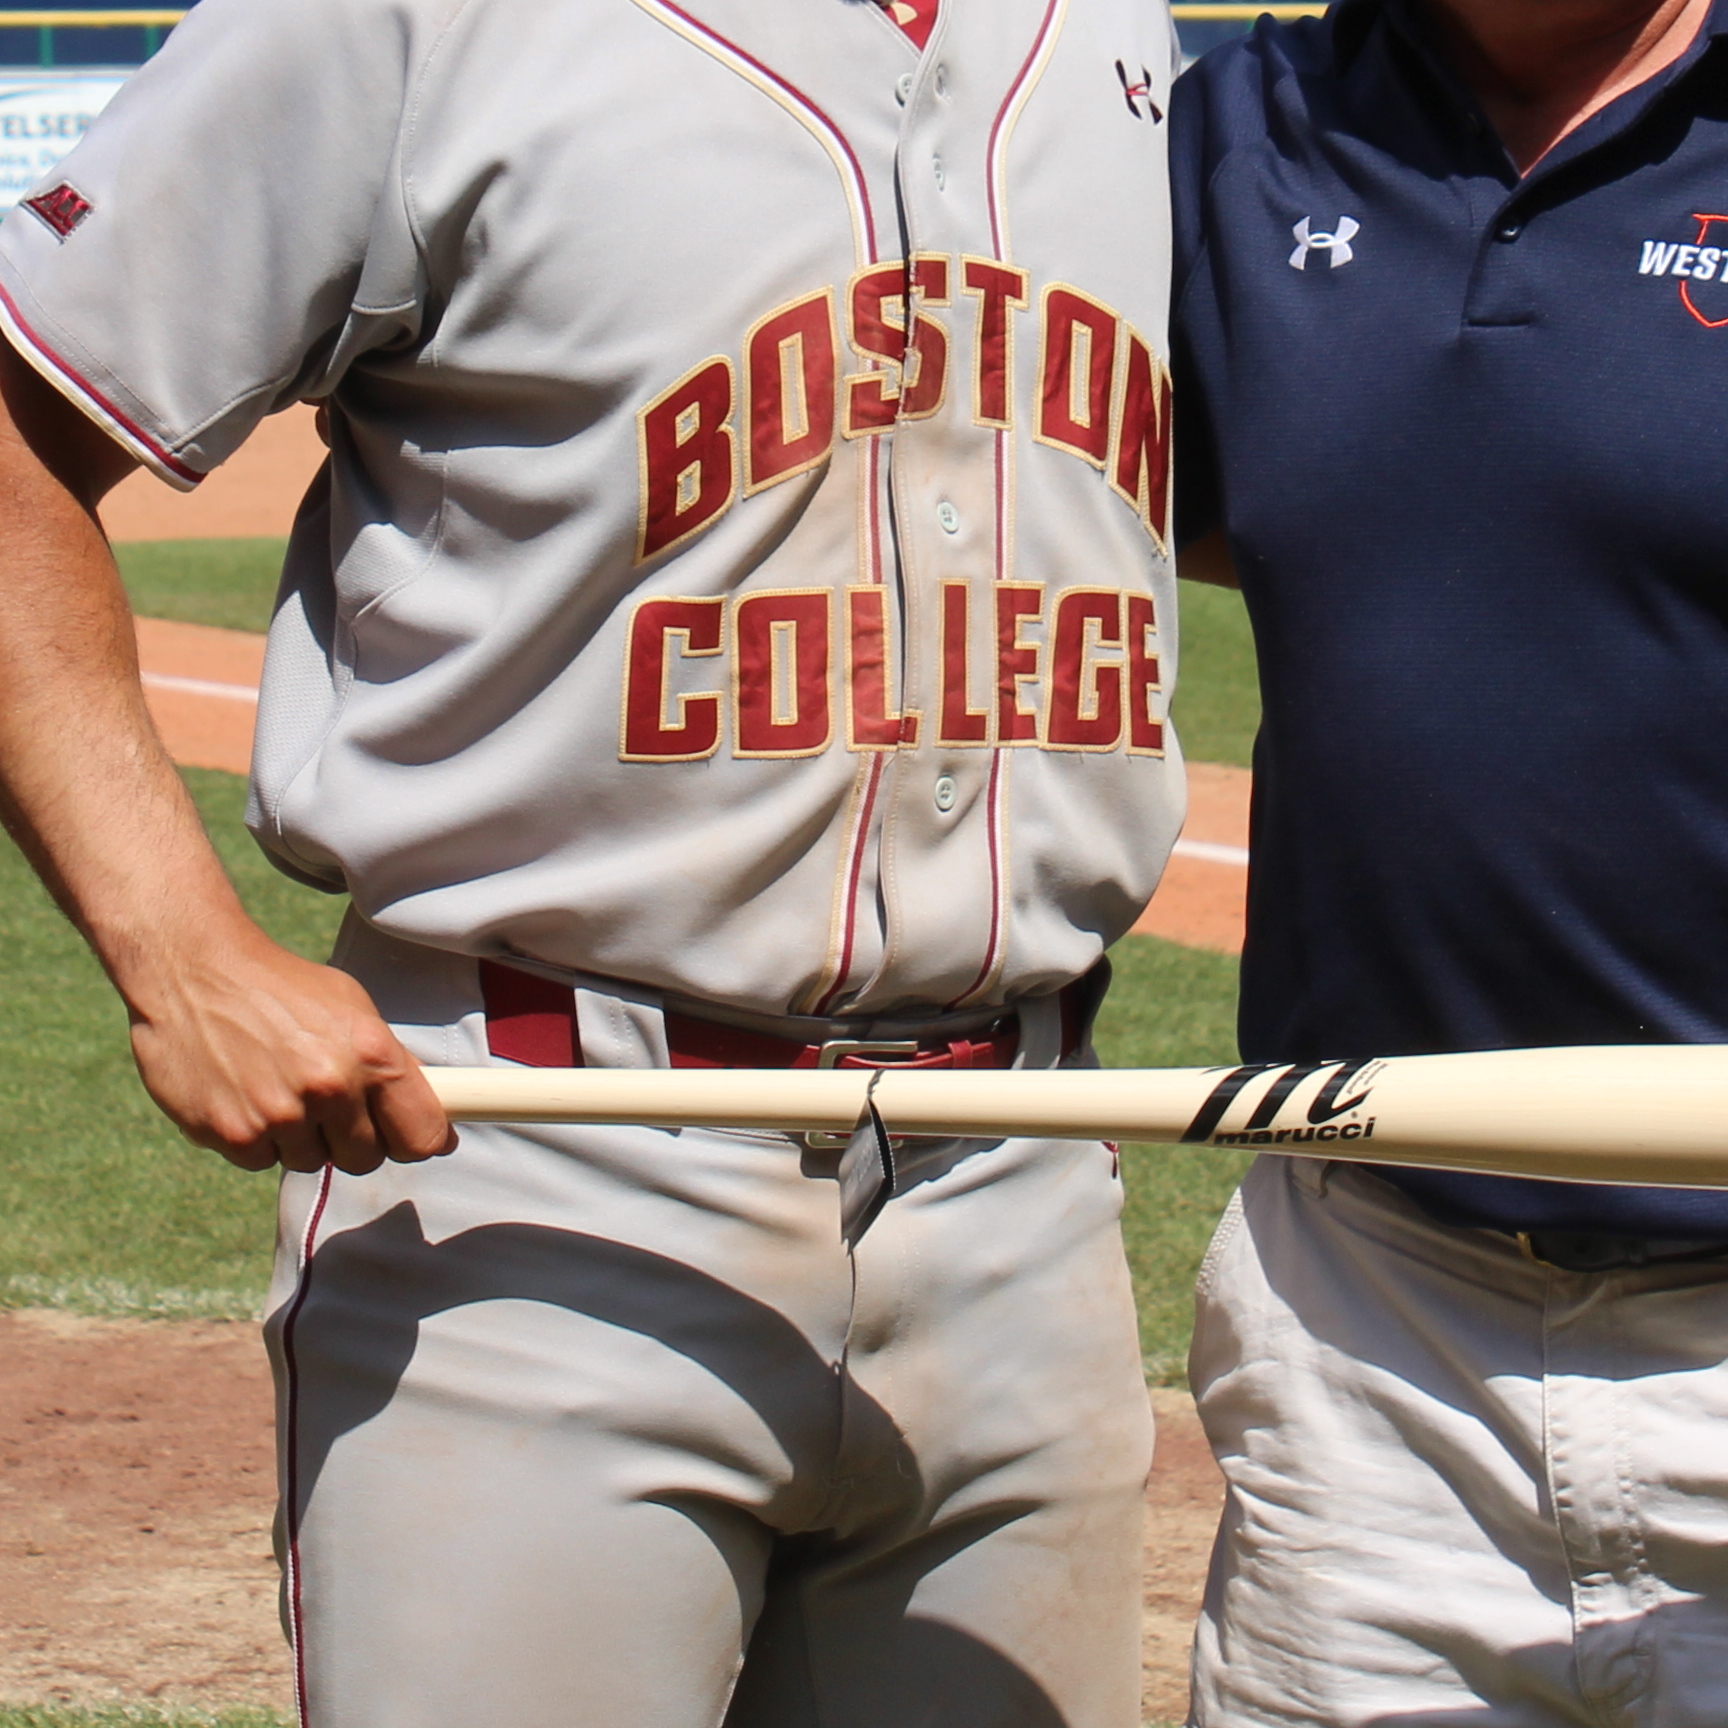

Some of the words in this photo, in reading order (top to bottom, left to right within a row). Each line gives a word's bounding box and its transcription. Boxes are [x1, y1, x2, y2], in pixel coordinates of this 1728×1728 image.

[635, 251, 1173, 567] BOSTON
[618, 577, 1165, 762] COLLEGE
[1213, 1116, 1377, 1145] marucci
